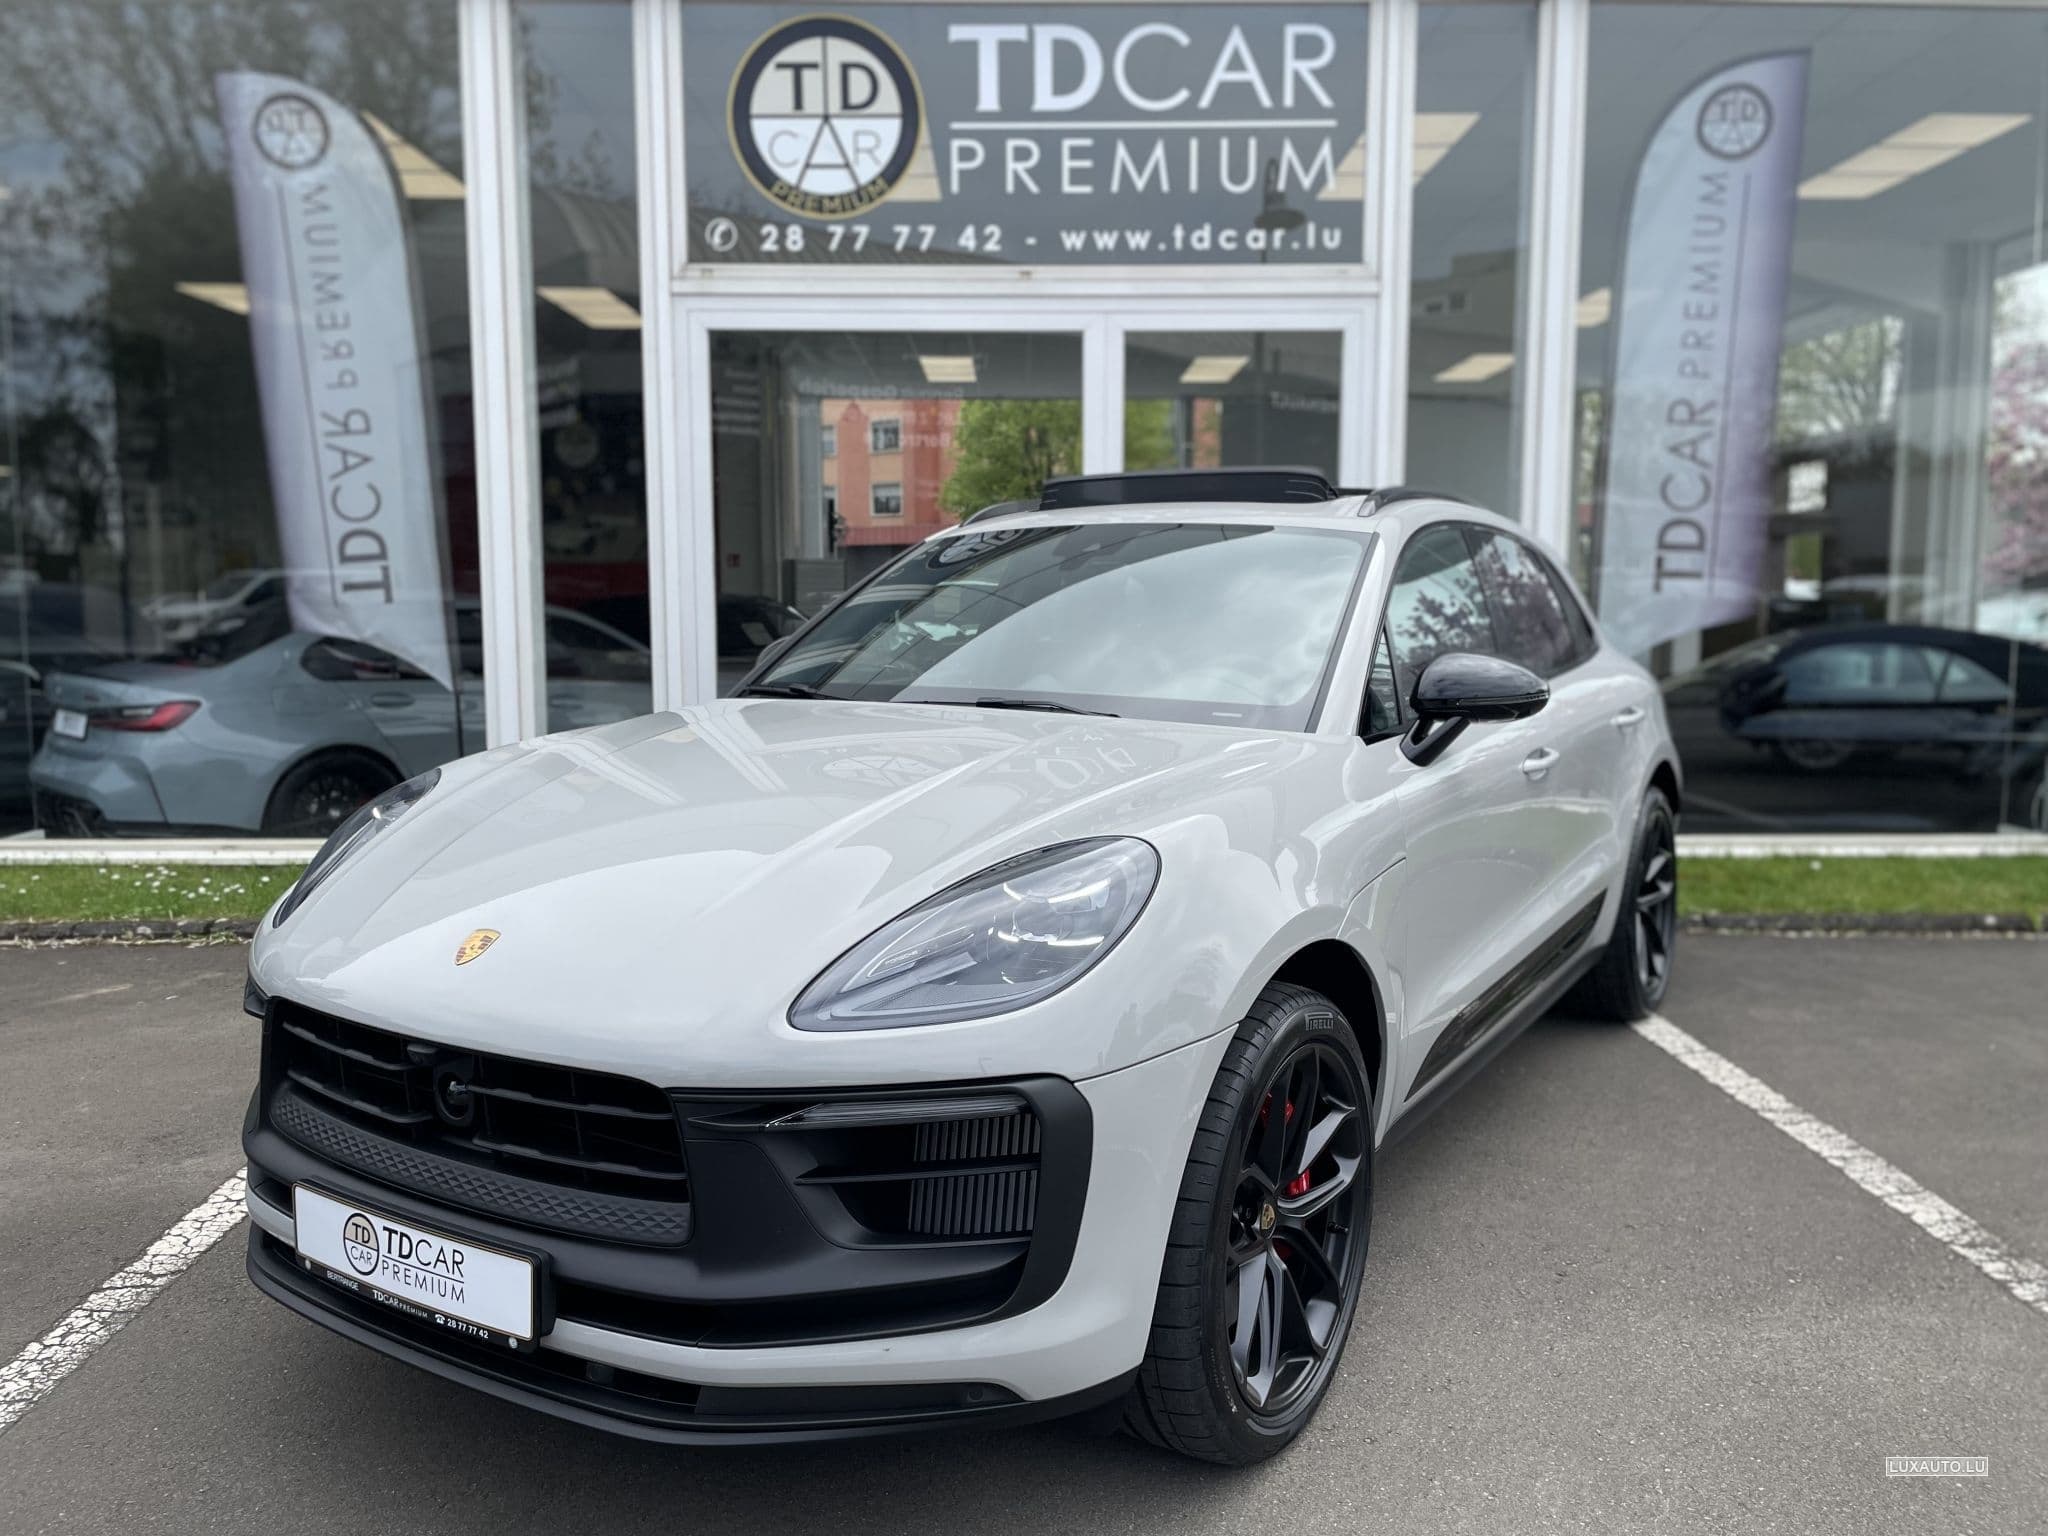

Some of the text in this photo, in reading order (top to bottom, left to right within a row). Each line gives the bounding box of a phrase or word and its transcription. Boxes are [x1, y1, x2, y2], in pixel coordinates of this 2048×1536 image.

[948, 22, 1337, 113] TDCAR
[768, 118, 883, 188] CAR
[950, 136, 1338, 195] PREMIUM
[770, 174, 889, 214] PREMIUM
[760, 224, 805, 251] 28
[827, 224, 870, 251] 77
[893, 224, 937, 251] 77
[958, 224, 1002, 251] 42
[1060, 221, 1342, 251] www.tdcar.lu
[1654, 171, 1728, 593] TDCAR PREMIUM
[1305, 1011, 1334, 1031] PIRELLI
[351, 1222, 371, 1244] TD
[382, 1226, 465, 1278] TDCAR
[350, 1245, 373, 1266] CAR
[381, 1260, 465, 1304] PREMIUM
[447, 1318, 457, 1328] 28
[457, 1321, 467, 1331] 77
[468, 1325, 477, 1335] 77
[479, 1329, 489, 1339] 42
